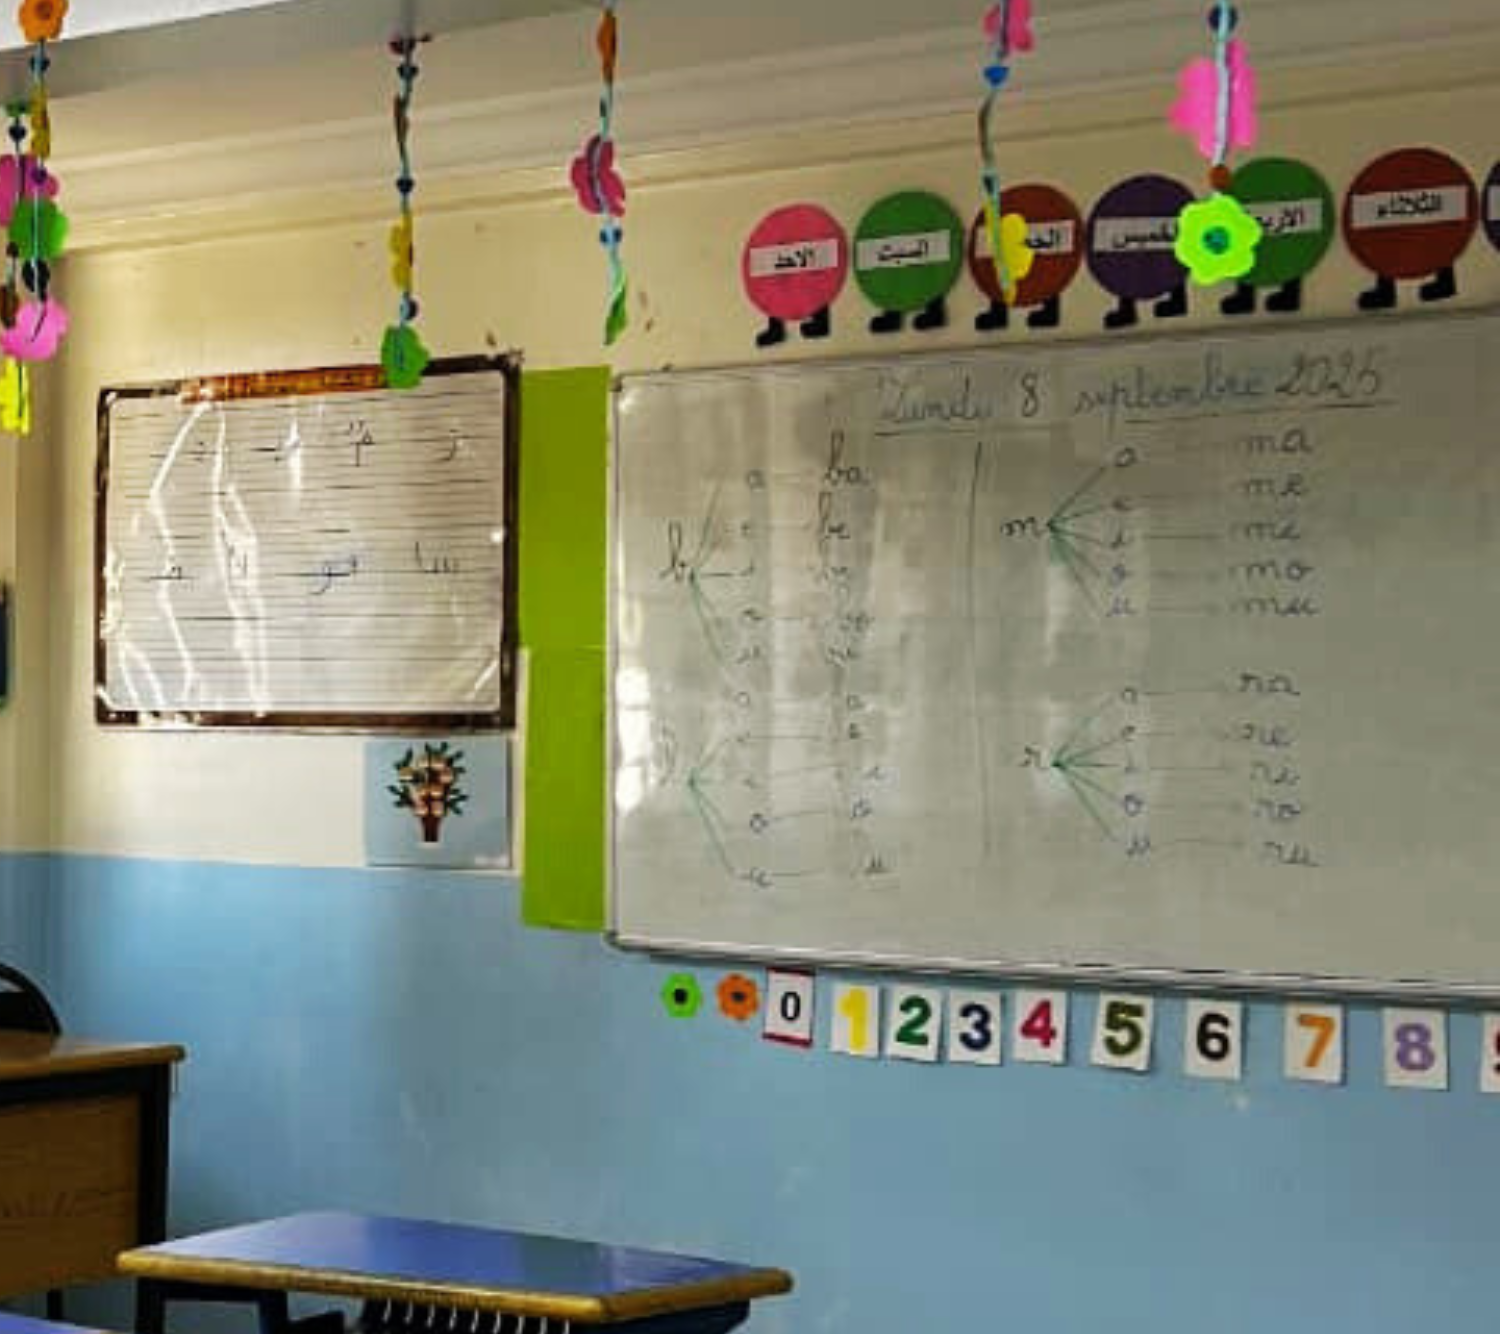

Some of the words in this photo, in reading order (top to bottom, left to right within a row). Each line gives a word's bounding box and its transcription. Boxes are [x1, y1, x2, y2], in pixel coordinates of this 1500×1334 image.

[1021, 371, 1040, 418] 8
[1275, 348, 1384, 399] 2025
[1240, 428, 1315, 456] ma
[780, 991, 801, 1022] 0
[838, 987, 869, 1056] 1
[895, 994, 932, 1047] 2
[958, 1002, 993, 1052] 3
[1019, 999, 1057, 1049] 4
[1104, 1000, 1146, 1057] 5
[1196, 1011, 1232, 1062] 6
[1297, 1013, 1337, 1068] 7
[1394, 1022, 1436, 1072] 8
